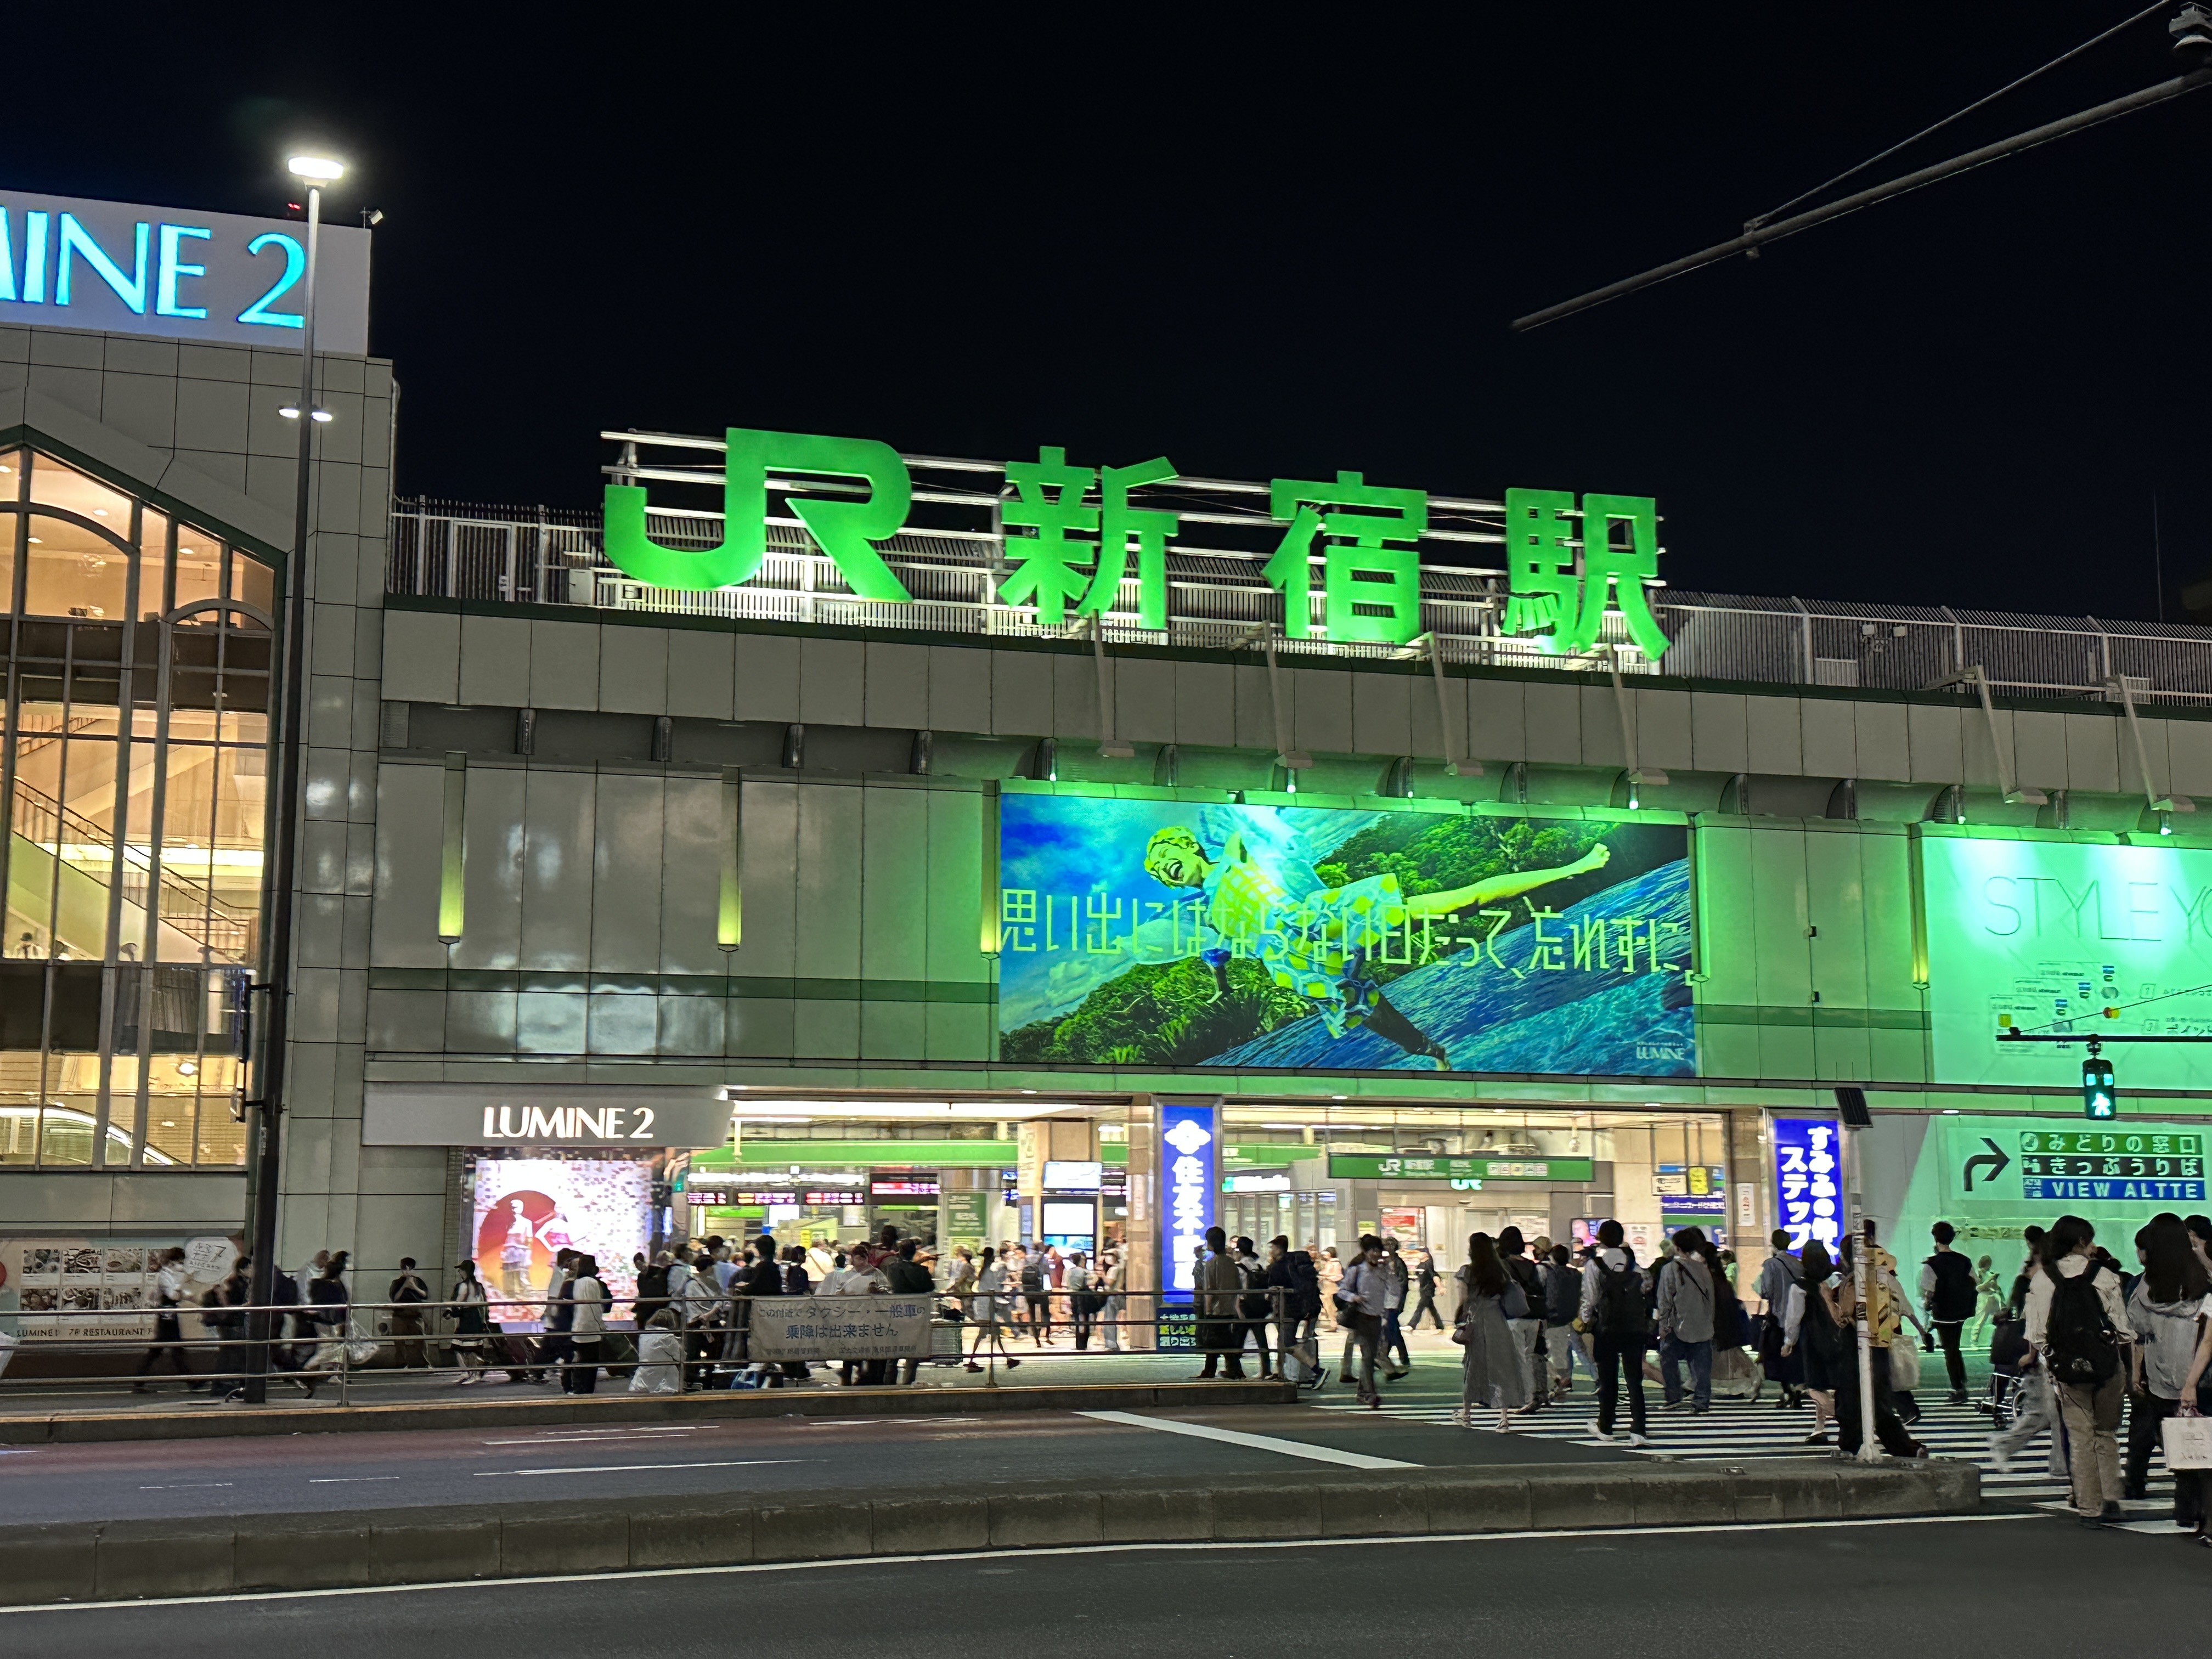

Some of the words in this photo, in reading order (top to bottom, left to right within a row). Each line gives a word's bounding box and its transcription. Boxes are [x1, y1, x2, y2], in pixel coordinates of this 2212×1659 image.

[236, 232, 306, 329] 2
[483, 1106, 625, 1138] LUMINE
[629, 1107, 654, 1138] 2
[2049, 1133, 2195, 1153] みどりの窓口
[1378, 1159, 1401, 1172] JR
[2052, 1182, 2111, 1197] VIEW
[2124, 1183, 2198, 1198] ALTTE
[17, 1329, 53, 1337] LUMINE
[83, 1328, 145, 1336] RESTAURANT
[786, 1323, 898, 1339] 乗降は出来ません
